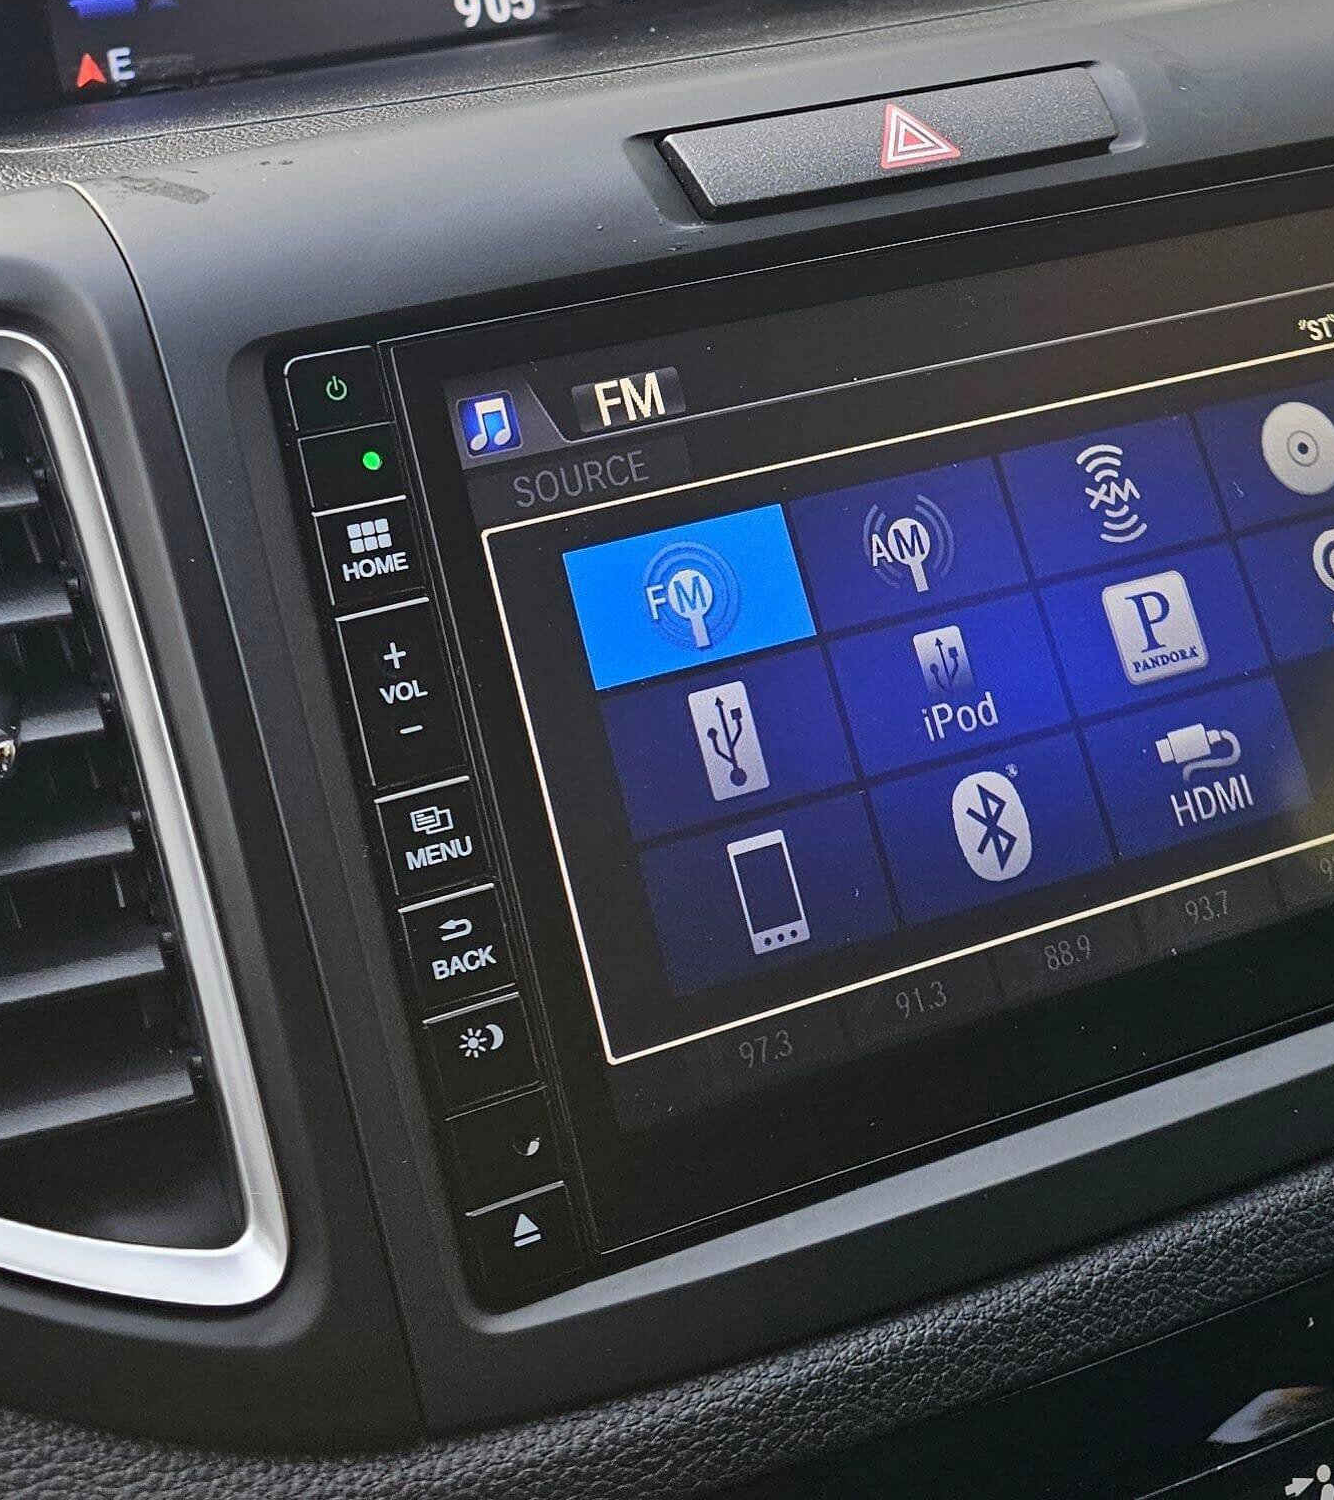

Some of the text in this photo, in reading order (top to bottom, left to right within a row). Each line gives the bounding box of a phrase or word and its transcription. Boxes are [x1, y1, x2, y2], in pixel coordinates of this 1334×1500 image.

[106, 46, 136, 83] E
[594, 372, 666, 427] FM
[513, 450, 649, 508] SOURCE
[1085, 477, 1141, 510] XM
[871, 524, 926, 568] AM
[342, 551, 410, 582] HOME
[645, 572, 709, 620] FM
[1132, 644, 1200, 674] PANDORA
[379, 679, 429, 705] VOL
[921, 691, 999, 742] iPod
[1169, 774, 1255, 827] HDMI
[405, 835, 474, 872] MENU
[432, 944, 498, 981] BACK
[739, 1029, 794, 1068] 97.3
[895, 980, 947, 1020] 91.3
[1044, 934, 1091, 970] 88.9
[1184, 889, 1229, 925] 93.7
